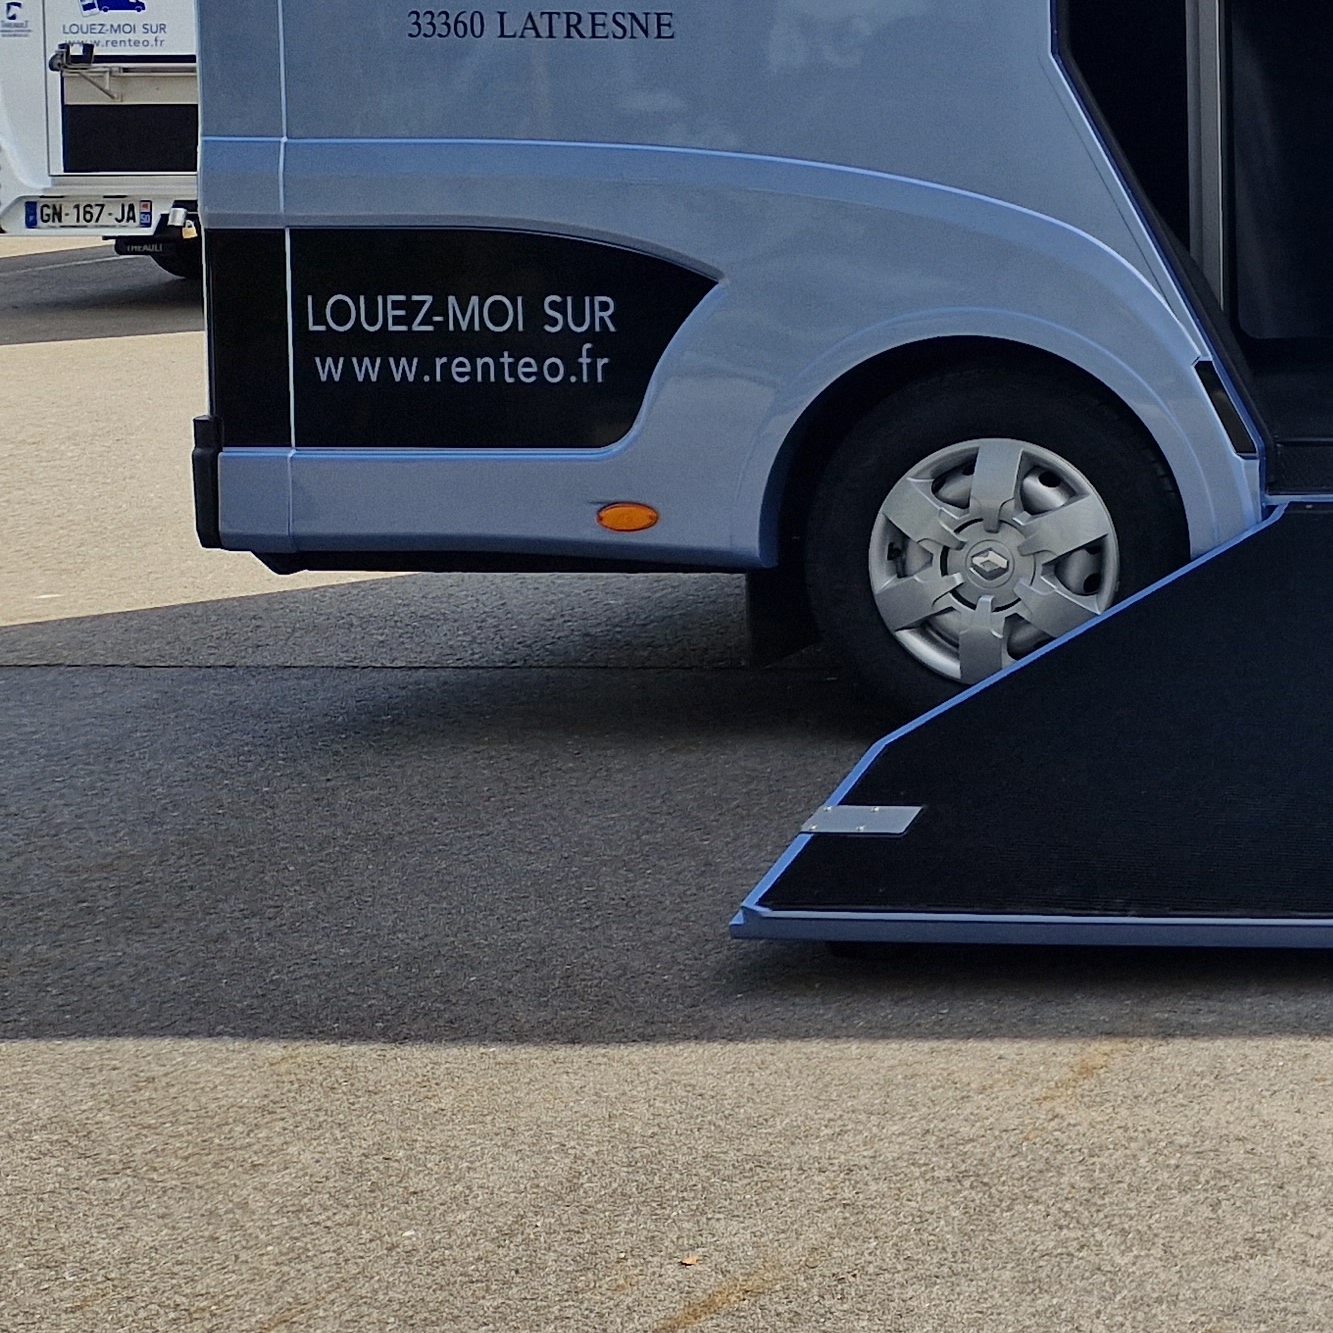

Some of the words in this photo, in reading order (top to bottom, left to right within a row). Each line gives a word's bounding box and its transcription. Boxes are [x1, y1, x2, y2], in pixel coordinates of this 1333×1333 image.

[62, 23, 137, 35] LOUEZ-MOI
[141, 23, 168, 35] SUR
[407, 10, 486, 40] 33360
[497, 11, 676, 40] LATRESNE
[306, 294, 525, 334] LOUEZ-MOI
[542, 294, 617, 334] SUR
[313, 342, 611, 384] www.renteo.fr
